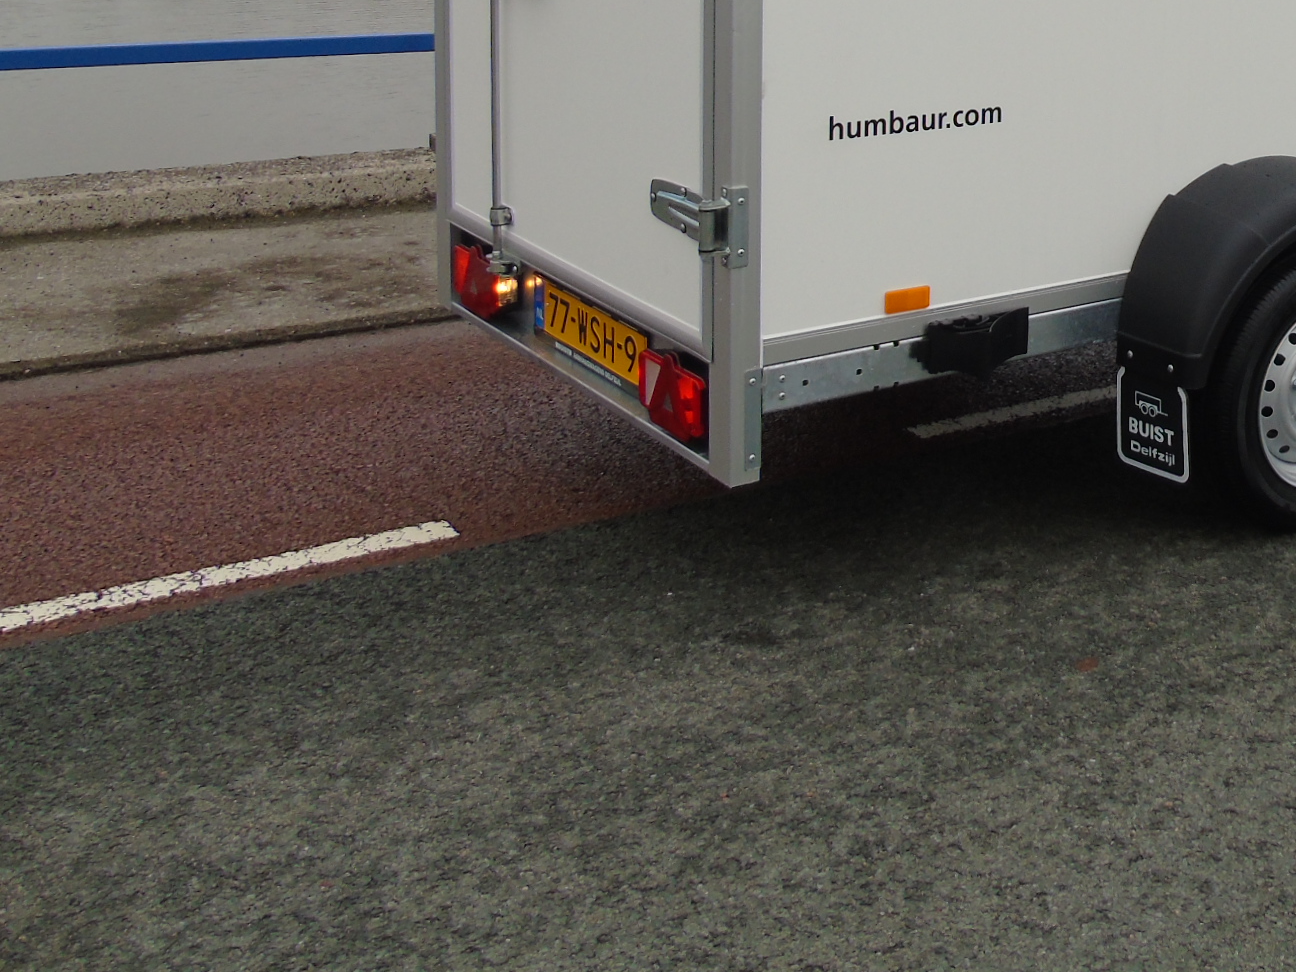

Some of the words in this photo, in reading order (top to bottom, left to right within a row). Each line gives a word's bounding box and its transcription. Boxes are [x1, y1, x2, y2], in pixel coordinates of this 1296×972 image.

[829, 106, 1002, 141] humbaur.com
[549, 291, 638, 373] 77-WSH-9
[1128, 416, 1175, 447] BUIST
[1130, 439, 1176, 467] Delfzijl
